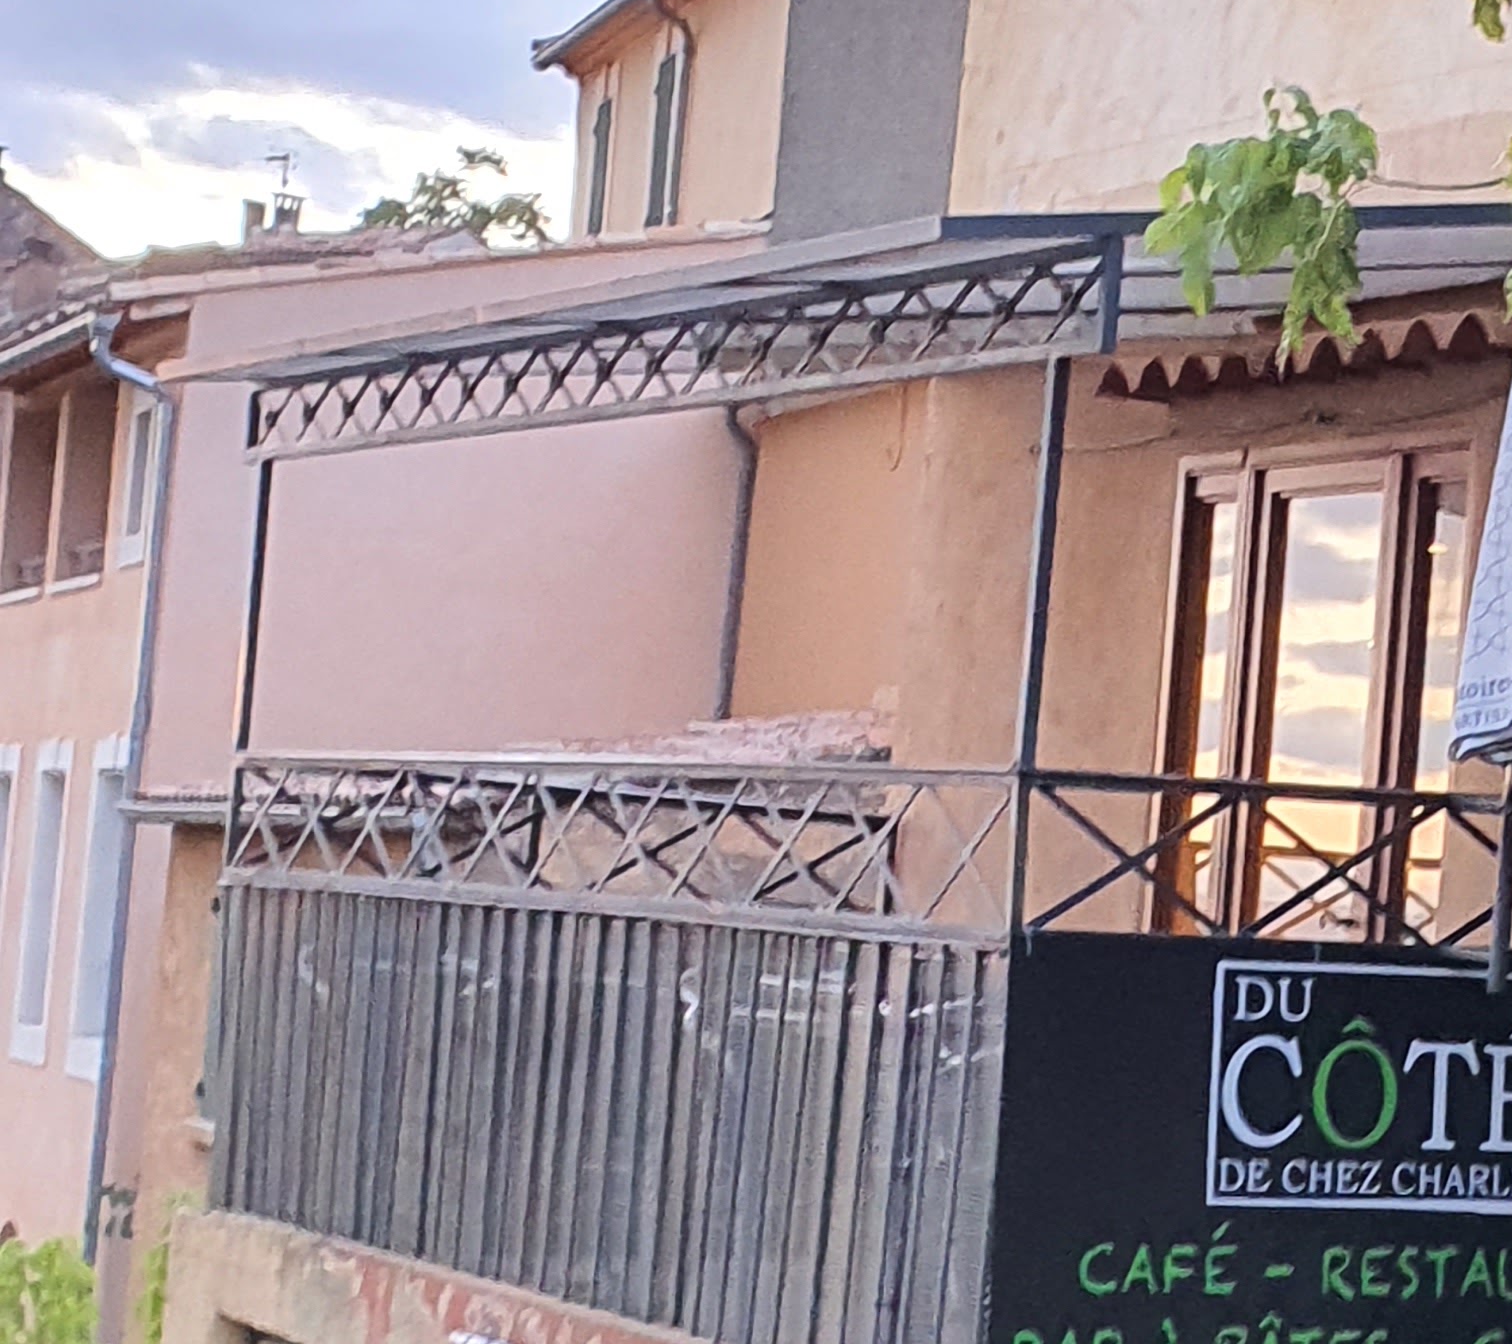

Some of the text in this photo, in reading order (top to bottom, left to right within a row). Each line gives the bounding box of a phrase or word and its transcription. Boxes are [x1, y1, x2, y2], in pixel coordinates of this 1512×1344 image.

[1232, 975, 1315, 1022] DU
[1219, 1157, 1273, 1194] DE
[1282, 1159, 1383, 1195] CHEZ
[1079, 1219, 1239, 1297] CAFÉ
[1263, 1263, 1295, 1278] -
